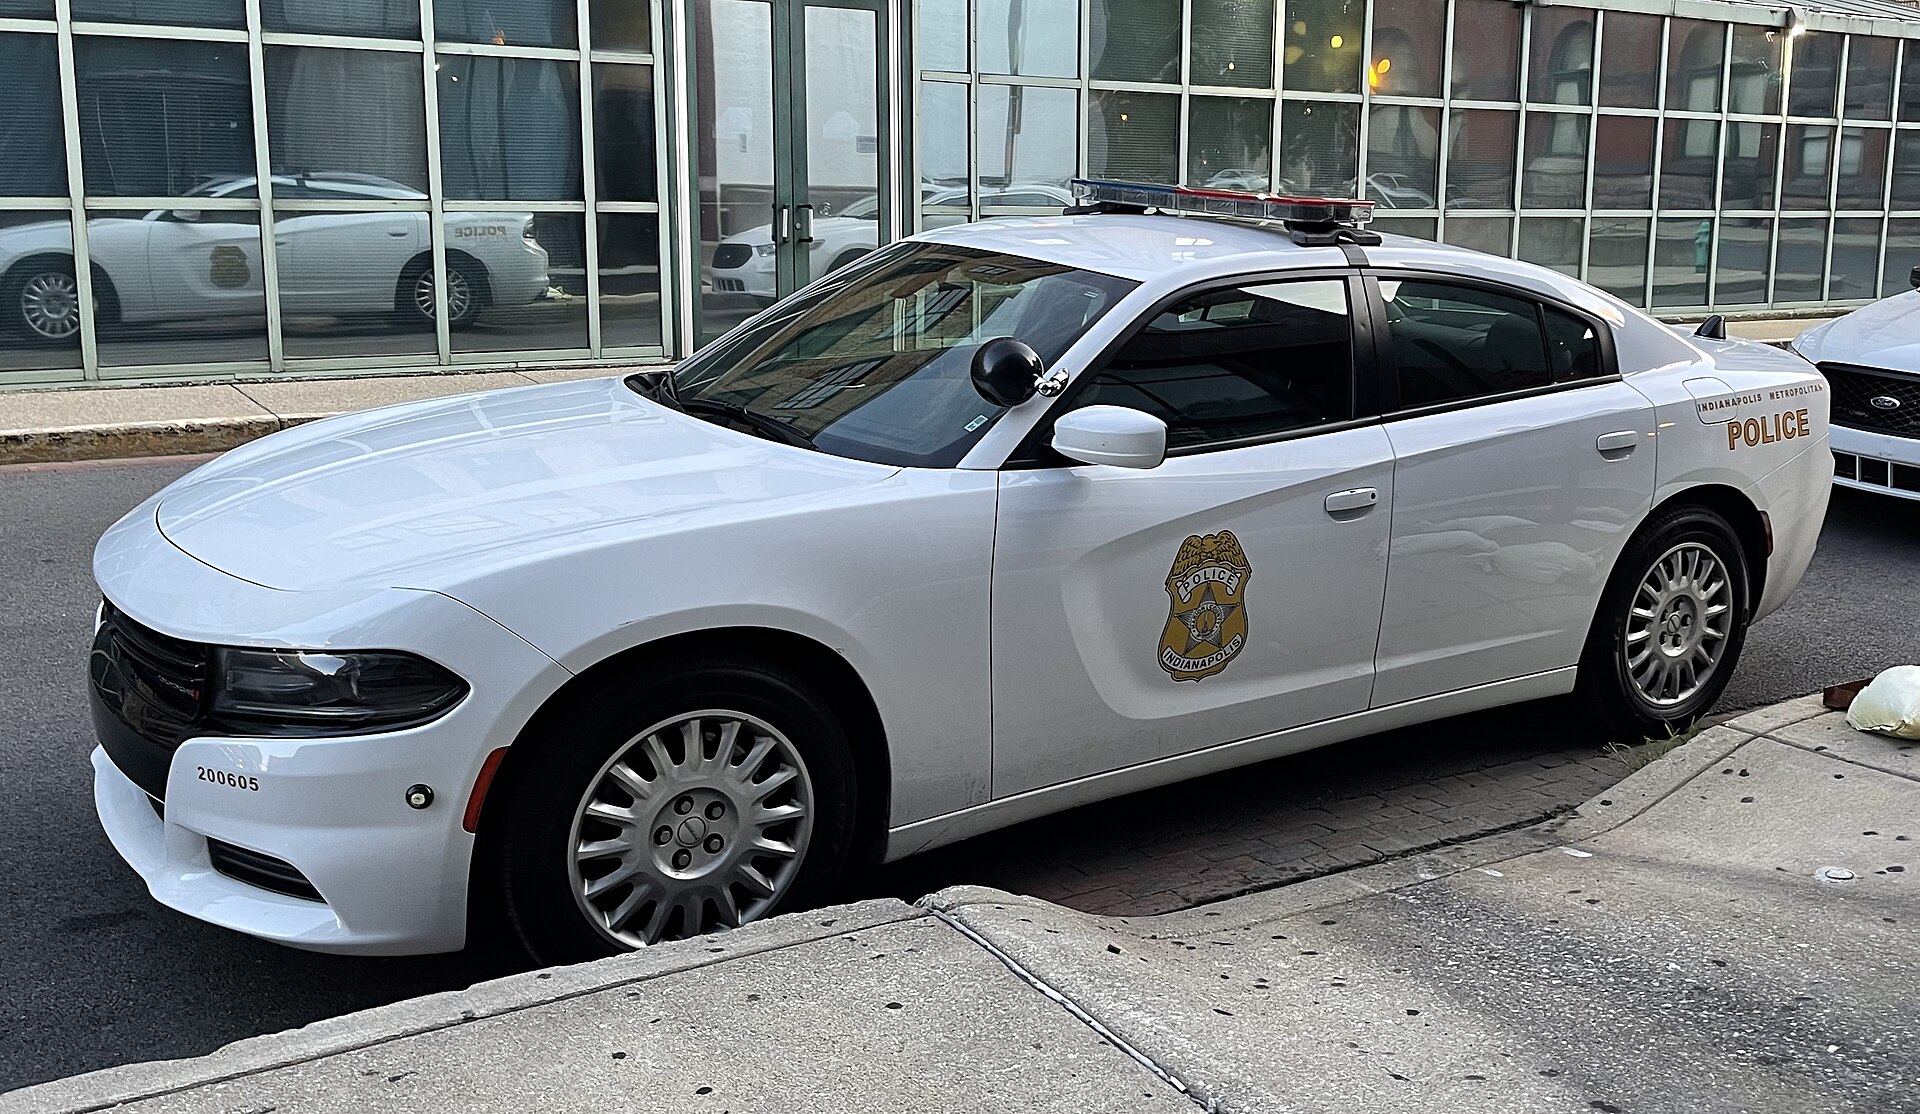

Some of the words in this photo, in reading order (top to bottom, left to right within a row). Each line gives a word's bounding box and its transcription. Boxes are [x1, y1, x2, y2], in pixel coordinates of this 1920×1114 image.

[1698, 394, 1762, 412] INDIANAPOLIS
[1769, 384, 1823, 400] METROPOLITAN
[1728, 408, 1810, 450] POLICE
[1183, 568, 1235, 592] POLICE
[1164, 638, 1241, 670] INDIANAPOLIS
[197, 766, 259, 791] 200605
